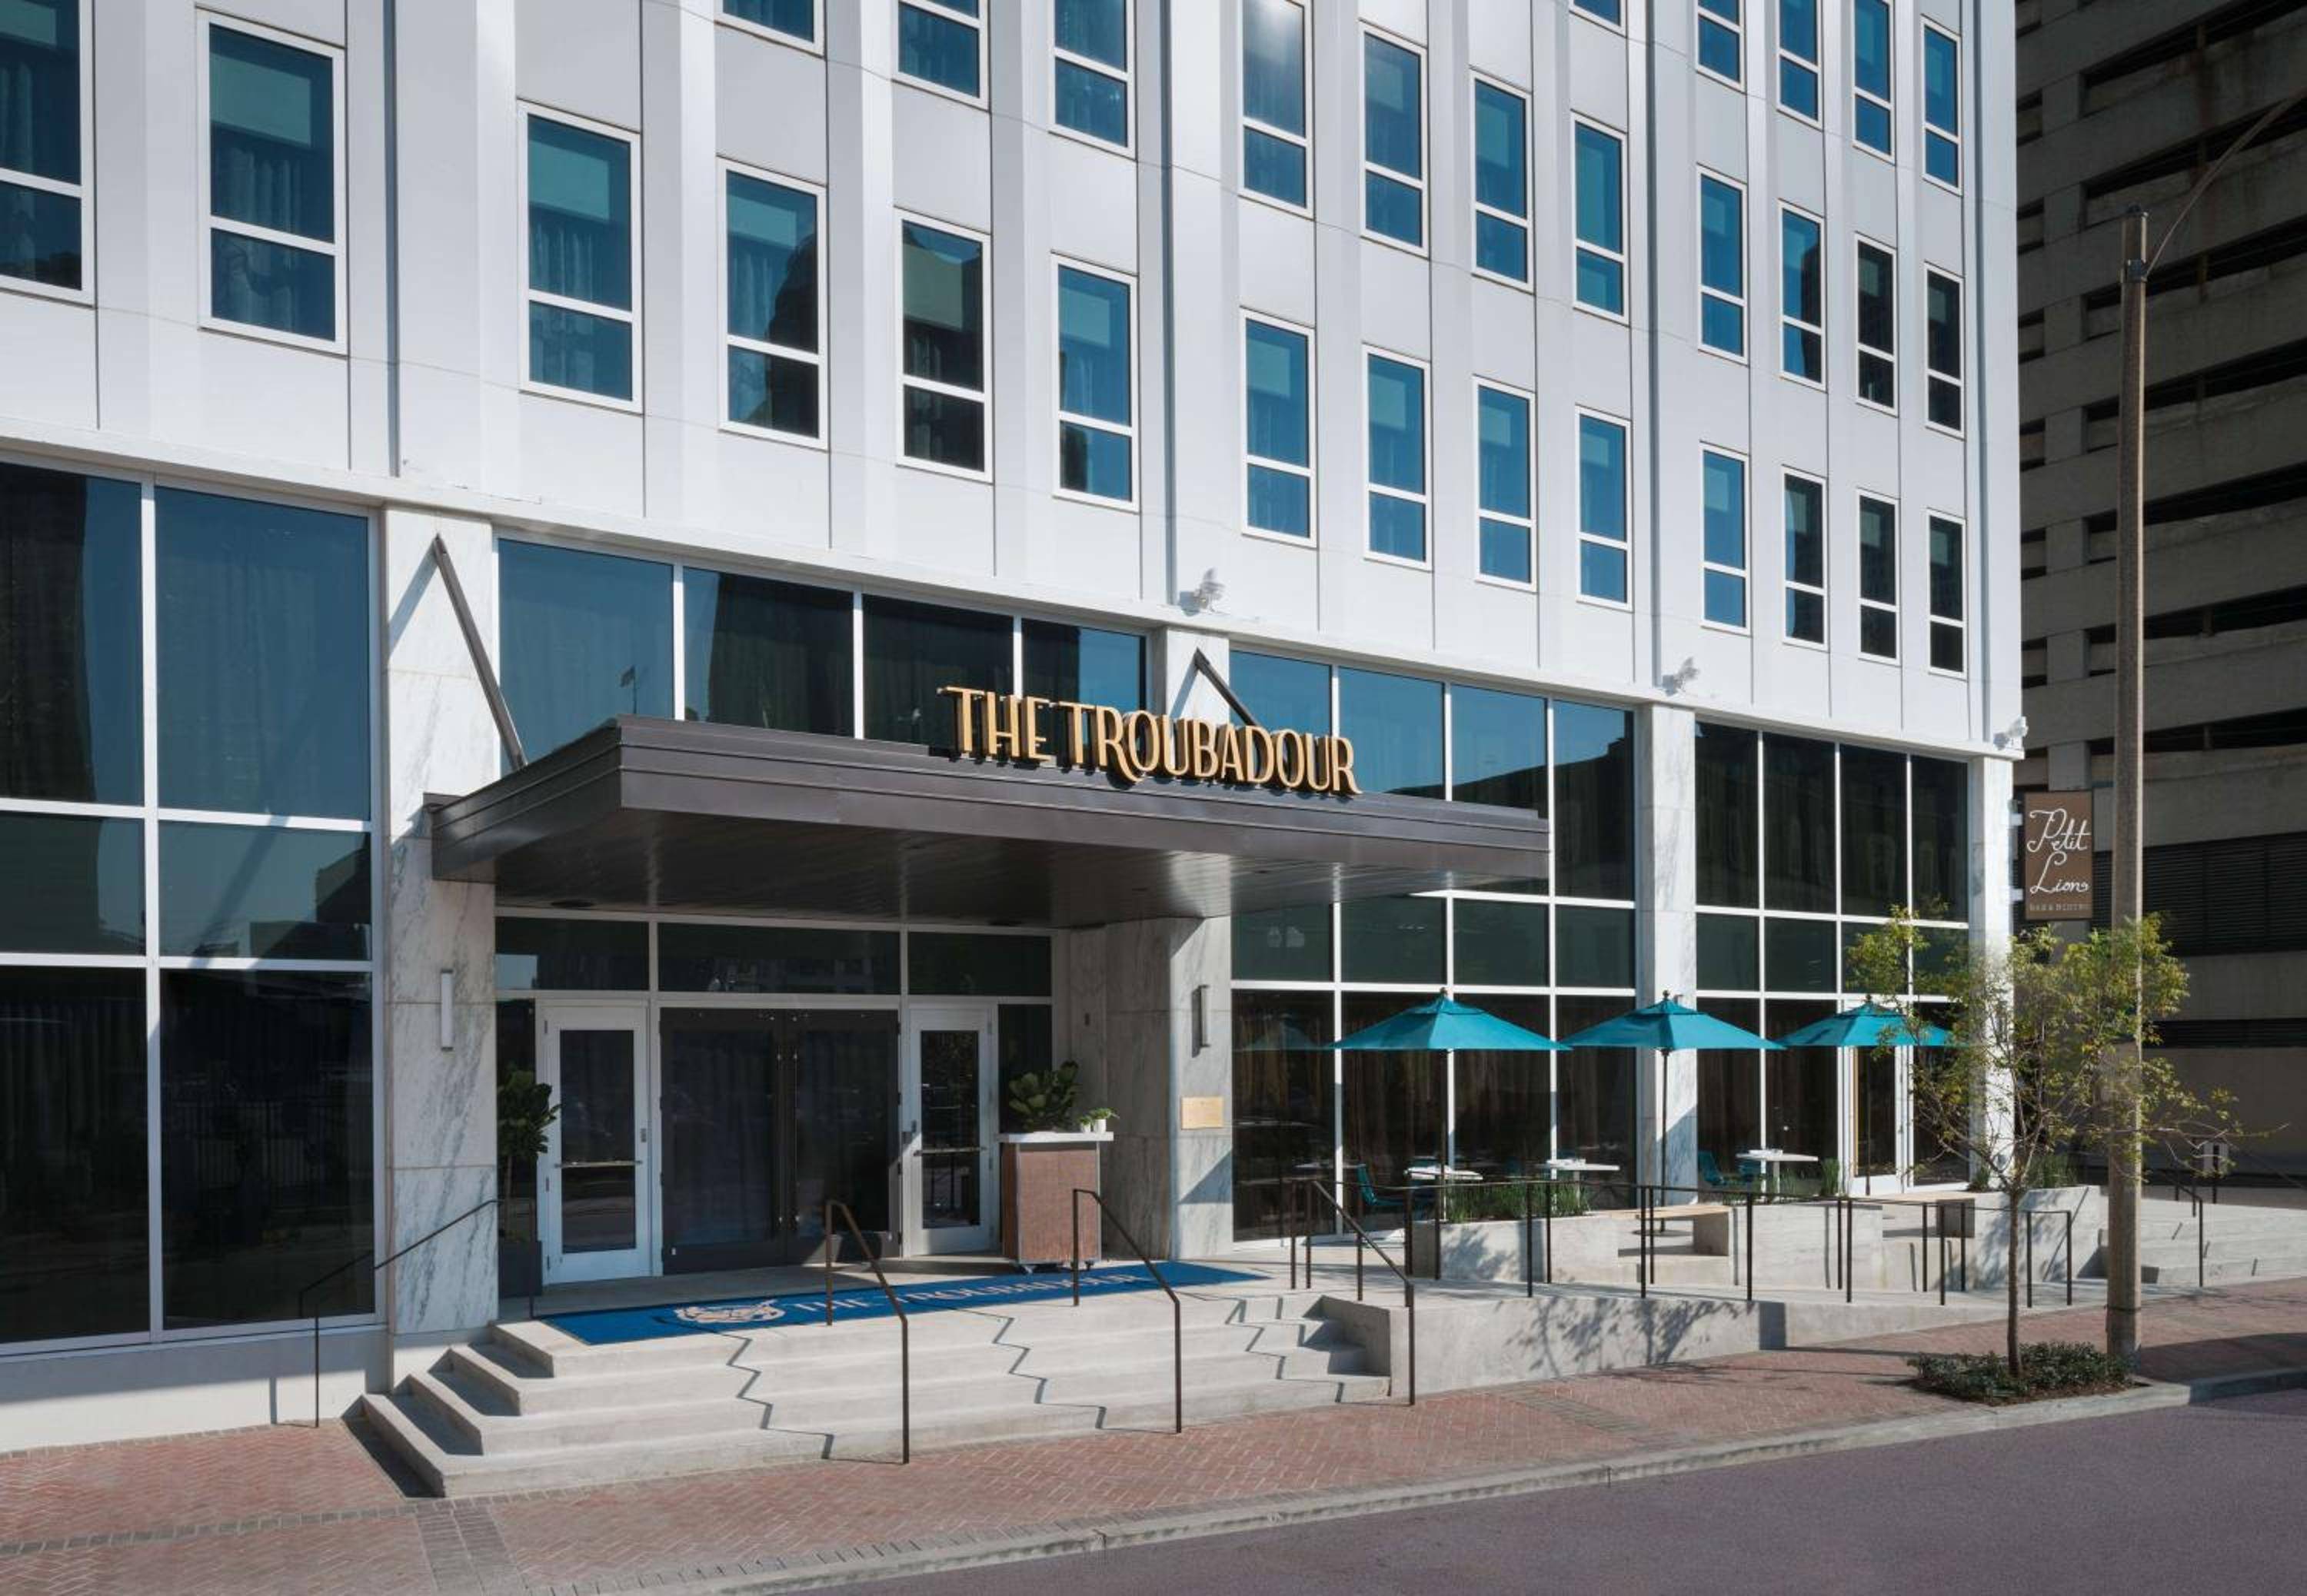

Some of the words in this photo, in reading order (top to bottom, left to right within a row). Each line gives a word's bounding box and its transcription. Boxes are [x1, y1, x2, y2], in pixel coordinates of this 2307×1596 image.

[937, 686, 1051, 762] THE
[1054, 700, 1363, 795] TROUBADOUR
[2027, 808, 2091, 852] Petit
